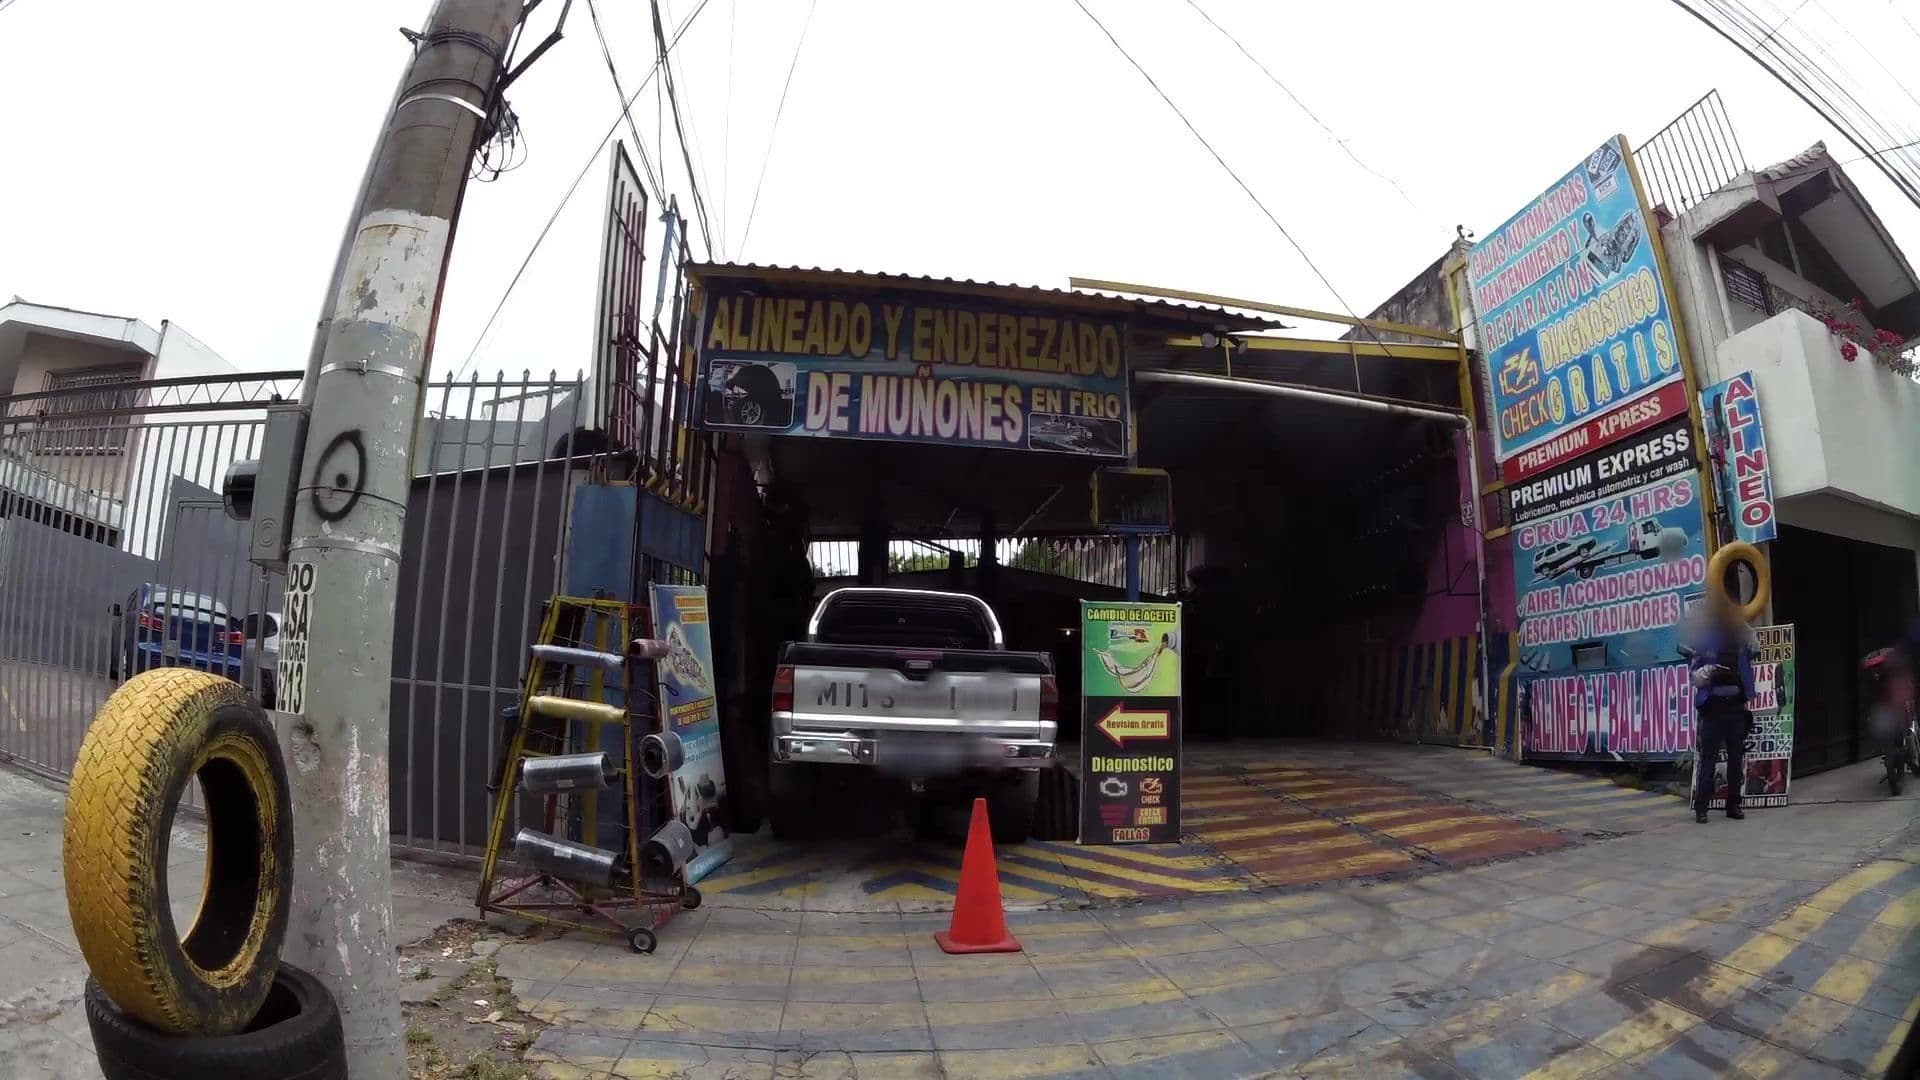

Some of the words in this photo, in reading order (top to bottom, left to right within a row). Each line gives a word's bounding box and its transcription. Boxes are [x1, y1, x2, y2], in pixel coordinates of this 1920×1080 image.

[1472, 233, 1508, 280] CAJAS
[1478, 228, 1572, 313] MANTENIMIENTO
[1568, 218, 1582, 251] Y
[707, 296, 872, 359] ALINEADO
[883, 304, 905, 360] Y
[913, 306, 1120, 378] ENDEREZADO
[1537, 267, 1659, 373] DIAGNOSTICO
[805, 371, 851, 432] DE
[859, 365, 1024, 443] MUÑONES
[1031, 387, 1062, 413] EN
[1069, 391, 1121, 418] FRIO
[1548, 320, 1673, 425] GRATIS
[1501, 390, 1550, 440] CHECK
[1518, 427, 1589, 473] PREMIUM
[1598, 397, 1662, 440] XPRESS
[1510, 464, 1592, 509] PREMIUM
[1598, 428, 1690, 479] EXPRESS
[1724, 377, 1773, 527] ALINEO
[1515, 502, 1559, 522] Lubricentro,
[1559, 490, 1596, 508] mecánica
[1597, 475, 1641, 497] automotriz
[1642, 471, 1649, 484] y
[1649, 465, 1664, 480] car
[1665, 456, 1690, 474] wash
[1518, 512, 1590, 551] GRUA
[1593, 499, 1626, 531] 24
[1630, 478, 1693, 522] HRS
[1087, 608, 1126, 621] CAMBIO
[1128, 609, 1142, 621] DE
[1143, 610, 1176, 622] ACEITE
[1526, 586, 1562, 616] AIRE
[1564, 554, 1706, 609] ACONDICIONADO
[1525, 610, 1580, 647] ESCAPES
[1580, 608, 1591, 642] Y
[1592, 593, 1681, 637] RADIADORES
[1531, 673, 1589, 754] ALINEO
[1590, 674, 1606, 753] Y
[1091, 756, 1174, 773] Diagnostico
[1141, 795, 1161, 804] CHECK
[1113, 828, 1149, 842] FALLAS
